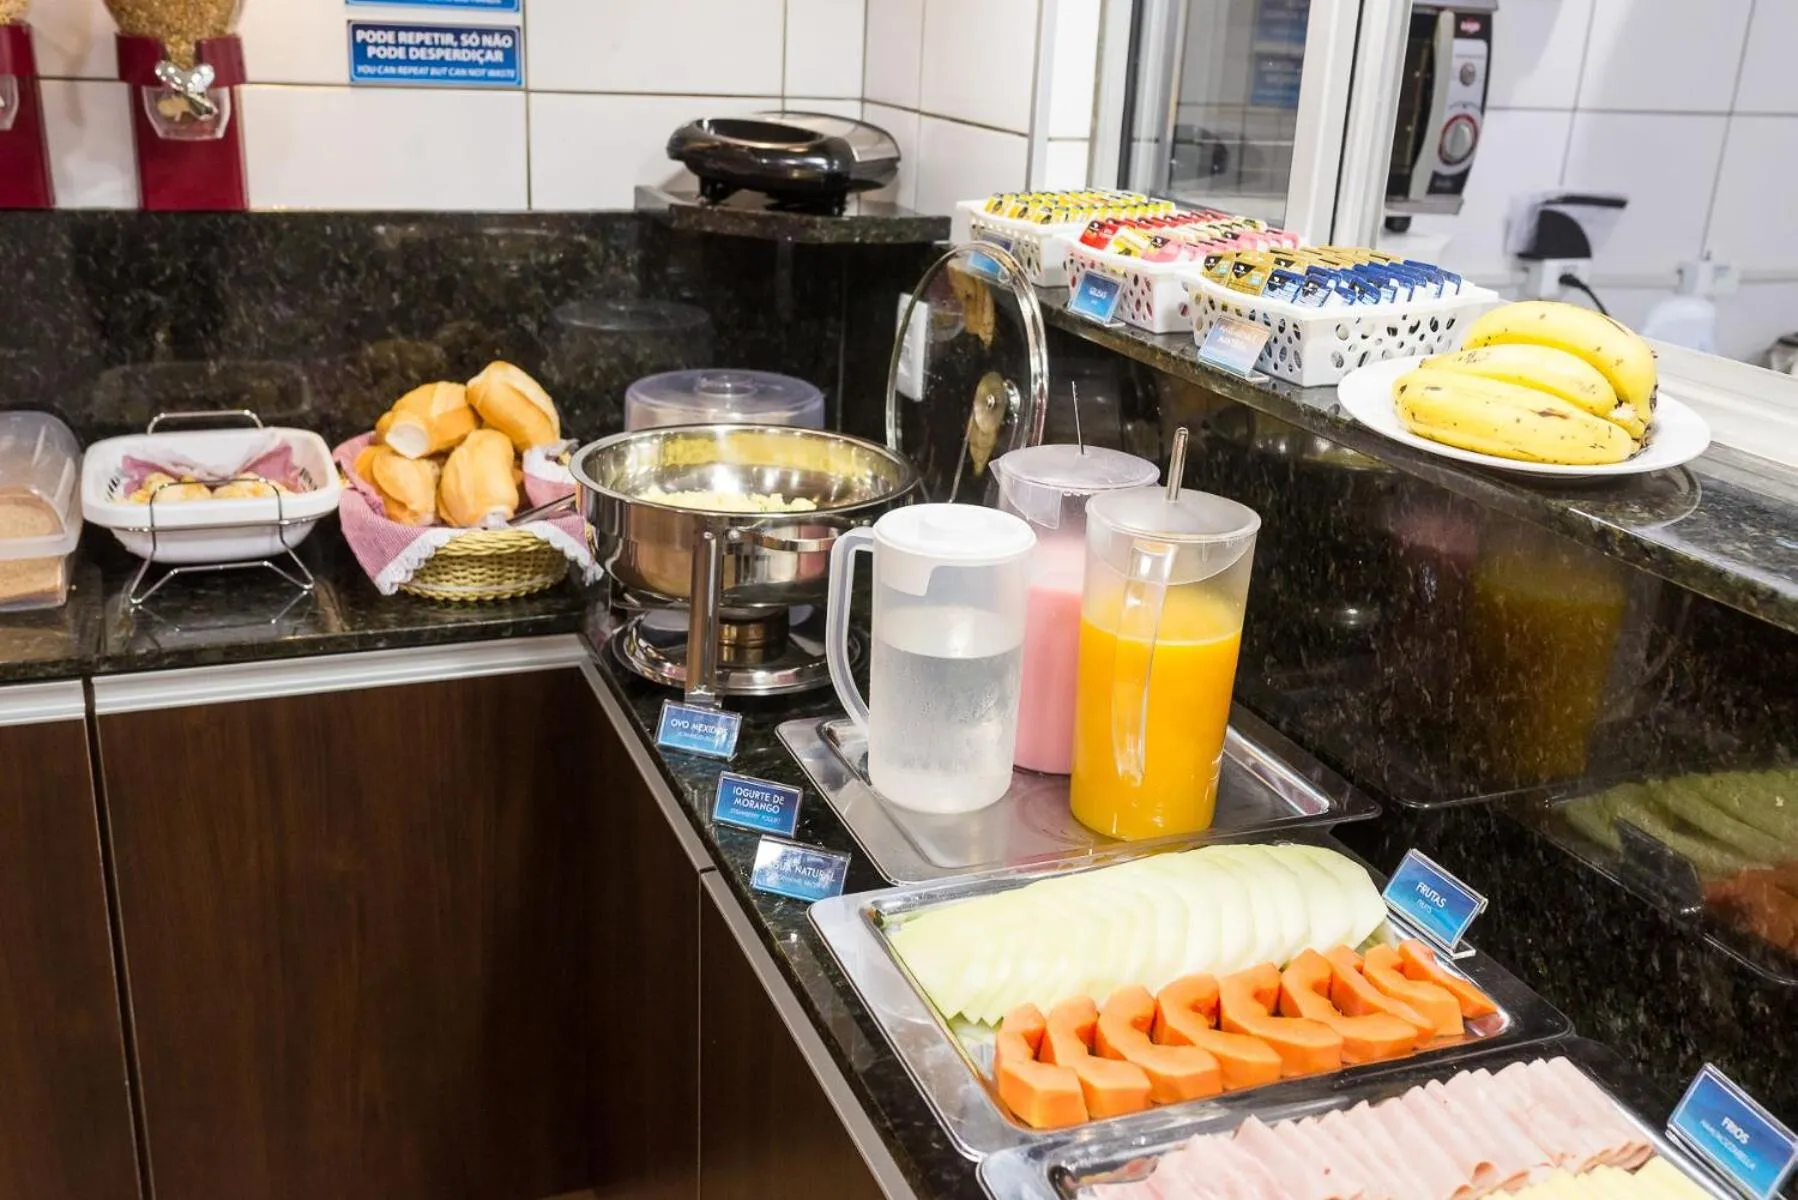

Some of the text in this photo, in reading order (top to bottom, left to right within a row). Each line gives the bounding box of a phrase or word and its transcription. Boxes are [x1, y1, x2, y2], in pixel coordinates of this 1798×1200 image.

[356, 29, 513, 49] PODE REPETIR, SÓ NÃO
[367, 46, 504, 64] PODE DESPERDIÇAR
[357, 65, 376, 74] YOU
[378, 65, 396, 74] CAN
[398, 65, 429, 76] REPEAT
[430, 67, 448, 76] BUT
[448, 67, 467, 77] CAN
[468, 68, 486, 77] NOT
[670, 718, 690, 729] OVO
[732, 785, 785, 805] IOGURTE DE
[733, 798, 780, 814] MORANGO
[1416, 882, 1446, 908] FRUTAS
